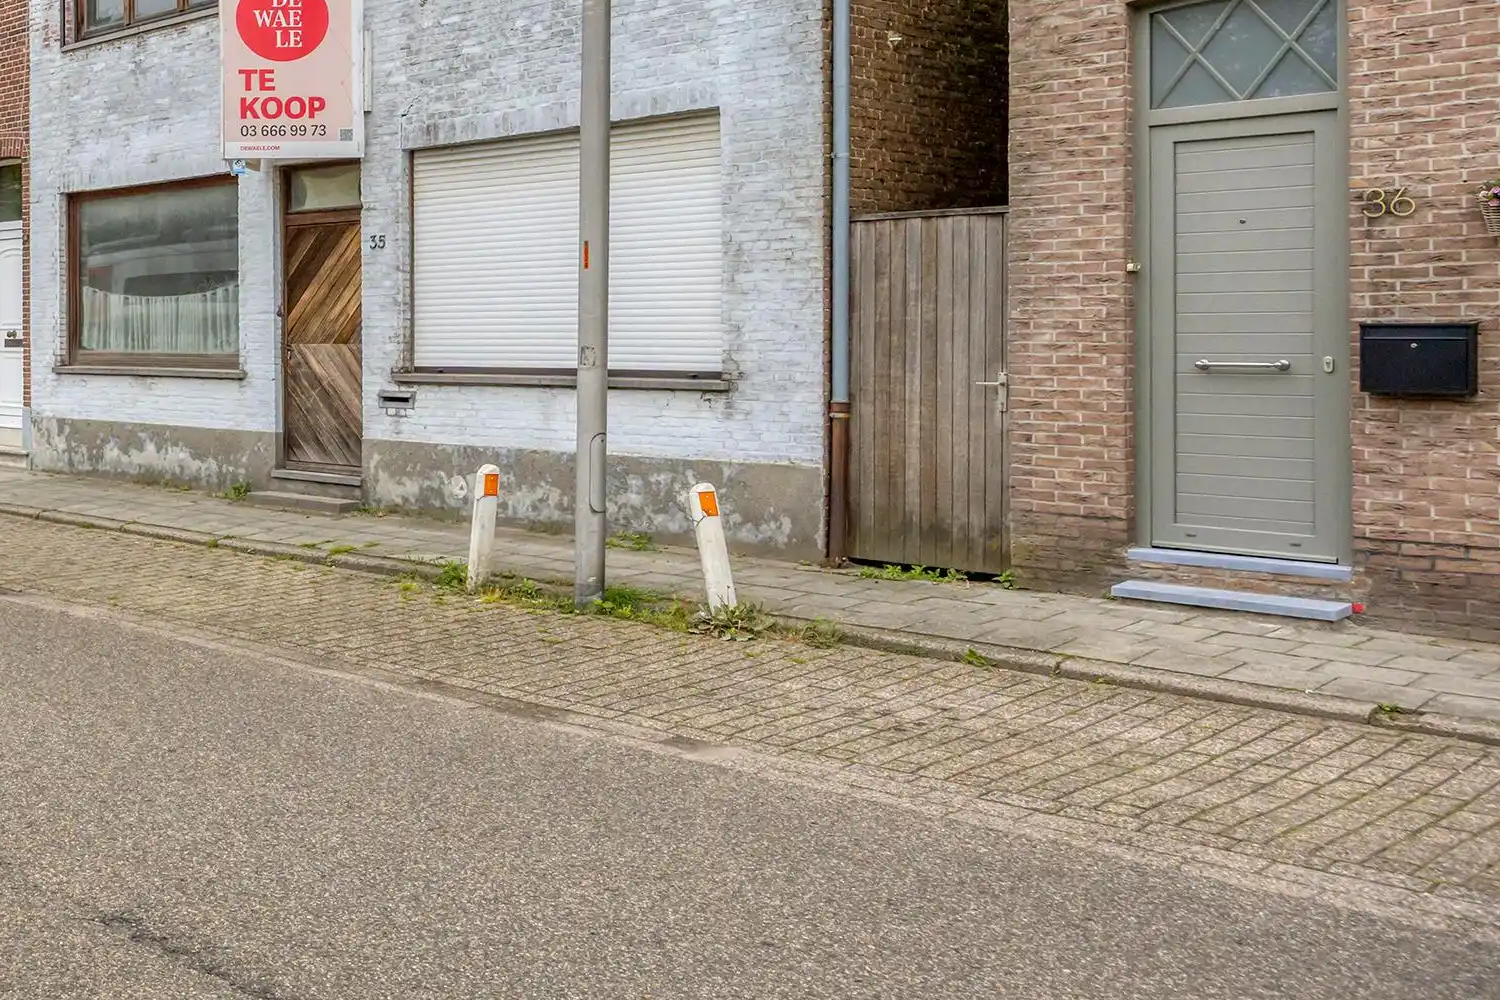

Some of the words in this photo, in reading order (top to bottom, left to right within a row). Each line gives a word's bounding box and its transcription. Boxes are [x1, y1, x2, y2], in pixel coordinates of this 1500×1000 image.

[254, 10, 303, 28] WAE
[275, 30, 303, 48] LE
[238, 69, 276, 92] TE
[240, 96, 326, 120] KOOP
[240, 125, 257, 137] 03
[261, 125, 287, 137] 666
[290, 125, 307, 137] 99
[311, 124, 327, 136] 73
[1363, 187, 1416, 218] 36
[369, 234, 386, 250] 35
